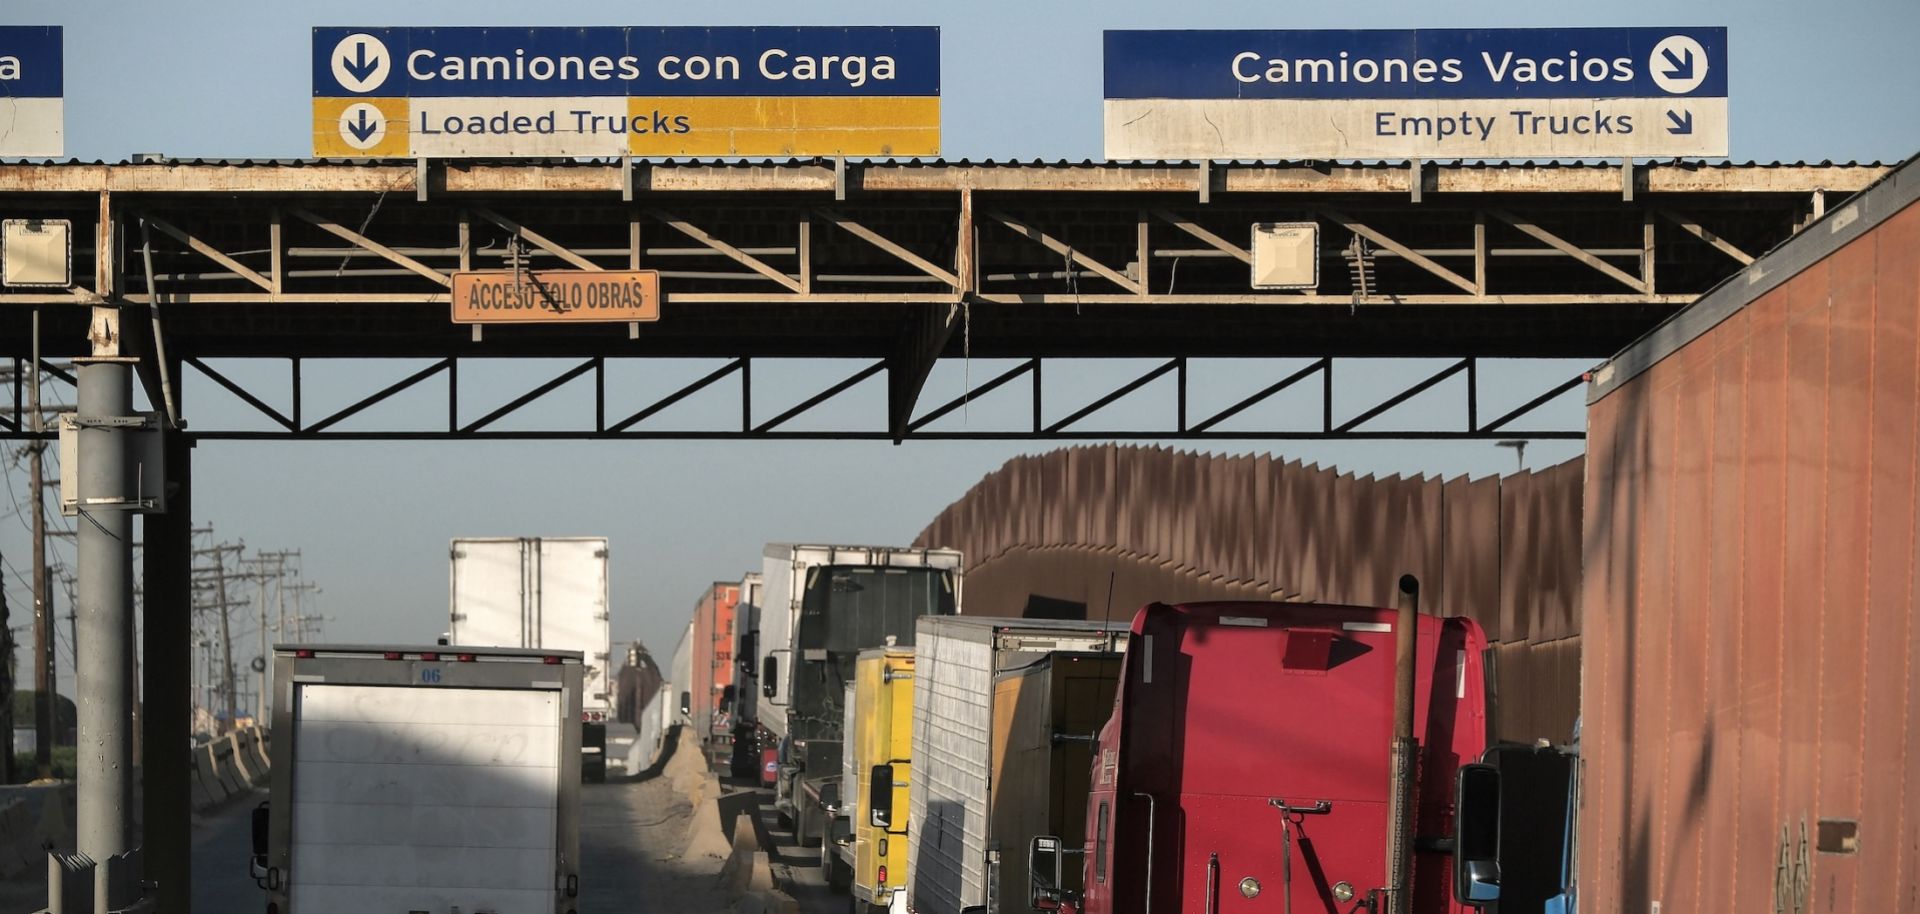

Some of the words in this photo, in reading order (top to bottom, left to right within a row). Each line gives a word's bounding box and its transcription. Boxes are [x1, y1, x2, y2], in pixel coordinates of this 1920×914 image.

[406, 48, 641, 81] Camiones
[657, 55, 740, 80] con
[758, 48, 896, 88] Carga
[1231, 51, 1463, 83] Camiones
[1481, 50, 1635, 82] Vacios
[420, 110, 555, 134] Loaded
[569, 110, 690, 134] Trucks
[1375, 110, 1496, 141] Empty
[1510, 109, 1634, 135] Trucks
[469, 282, 535, 310] ACCESO
[587, 281, 643, 308] OBRAS
[421, 668, 442, 685] 06
